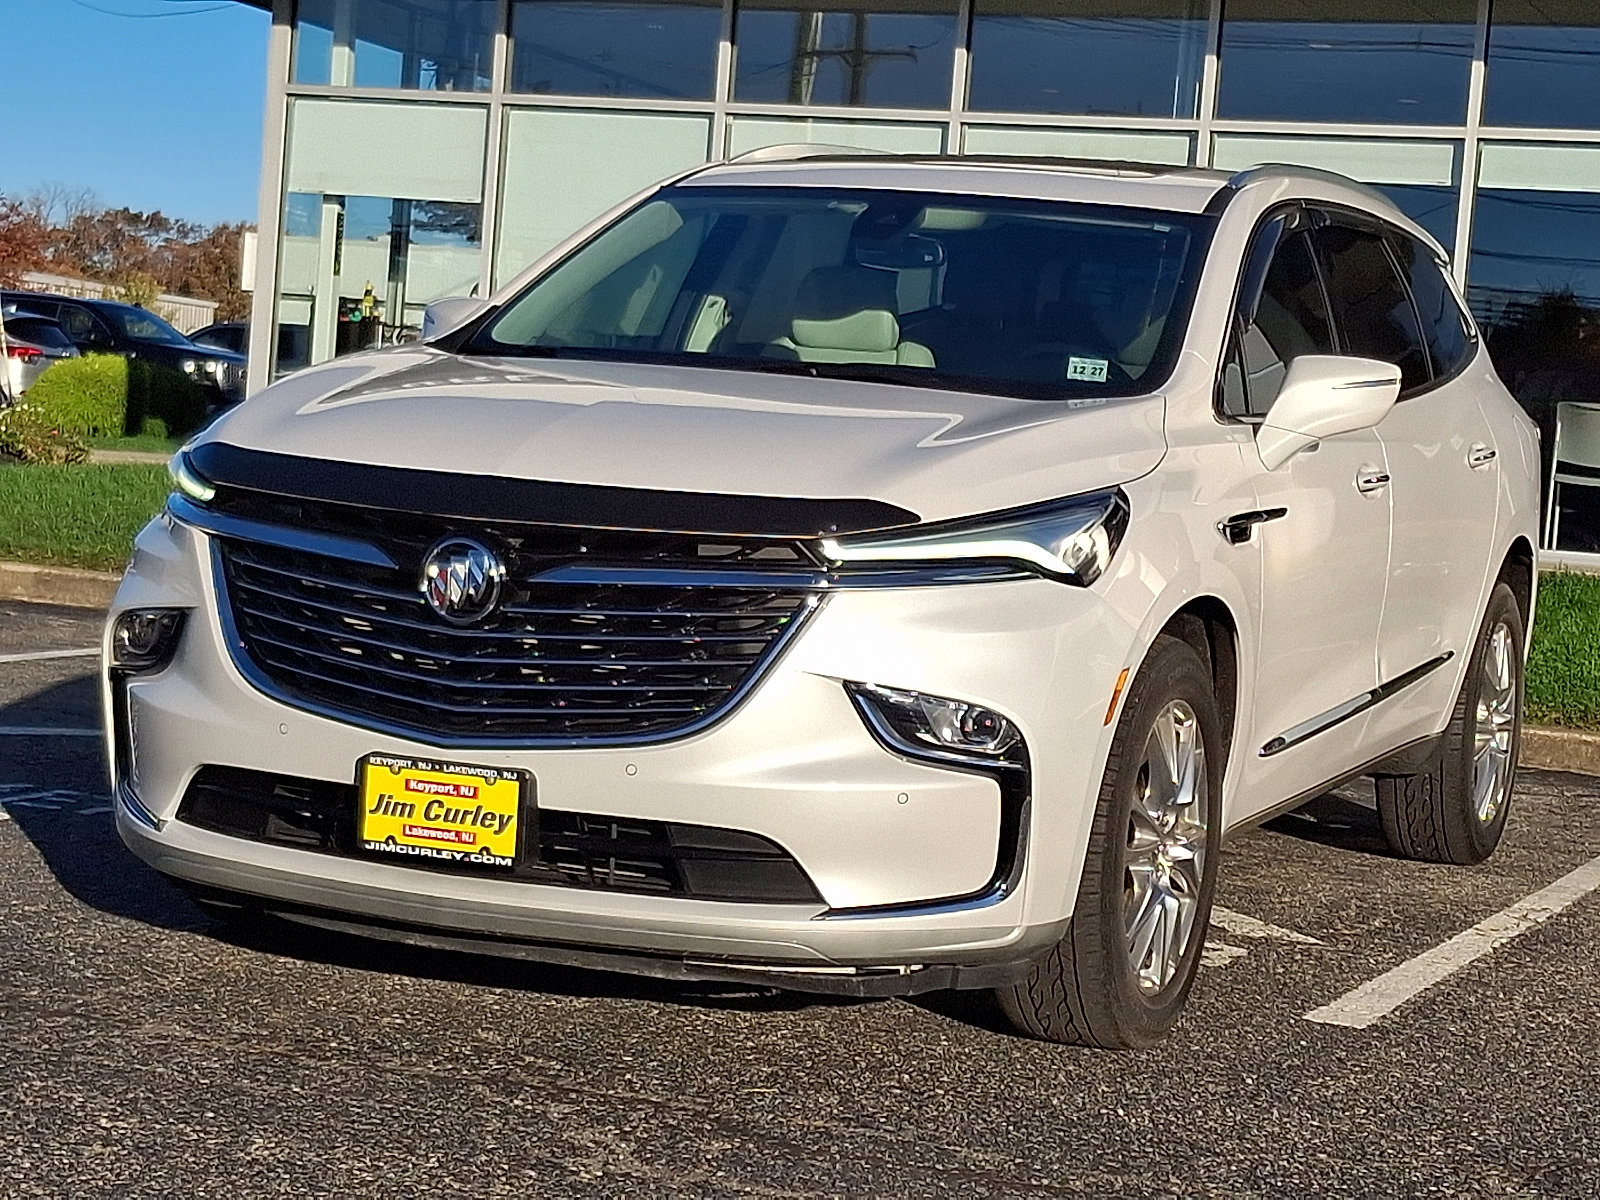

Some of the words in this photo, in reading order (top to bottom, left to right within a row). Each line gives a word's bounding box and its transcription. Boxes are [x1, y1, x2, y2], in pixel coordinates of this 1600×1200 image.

[1072, 365, 1086, 374] 12
[1091, 367, 1104, 376] 27
[418, 762, 432, 771] NJ
[503, 771, 518, 780] NJ
[409, 780, 458, 796] Keyport,
[460, 786, 475, 797] NJ
[369, 793, 416, 819] Jim
[423, 799, 514, 836] Curley
[405, 827, 459, 842] Lakewood,
[461, 832, 474, 843] NJ
[365, 842, 513, 866] JIMCURLEY.COM
